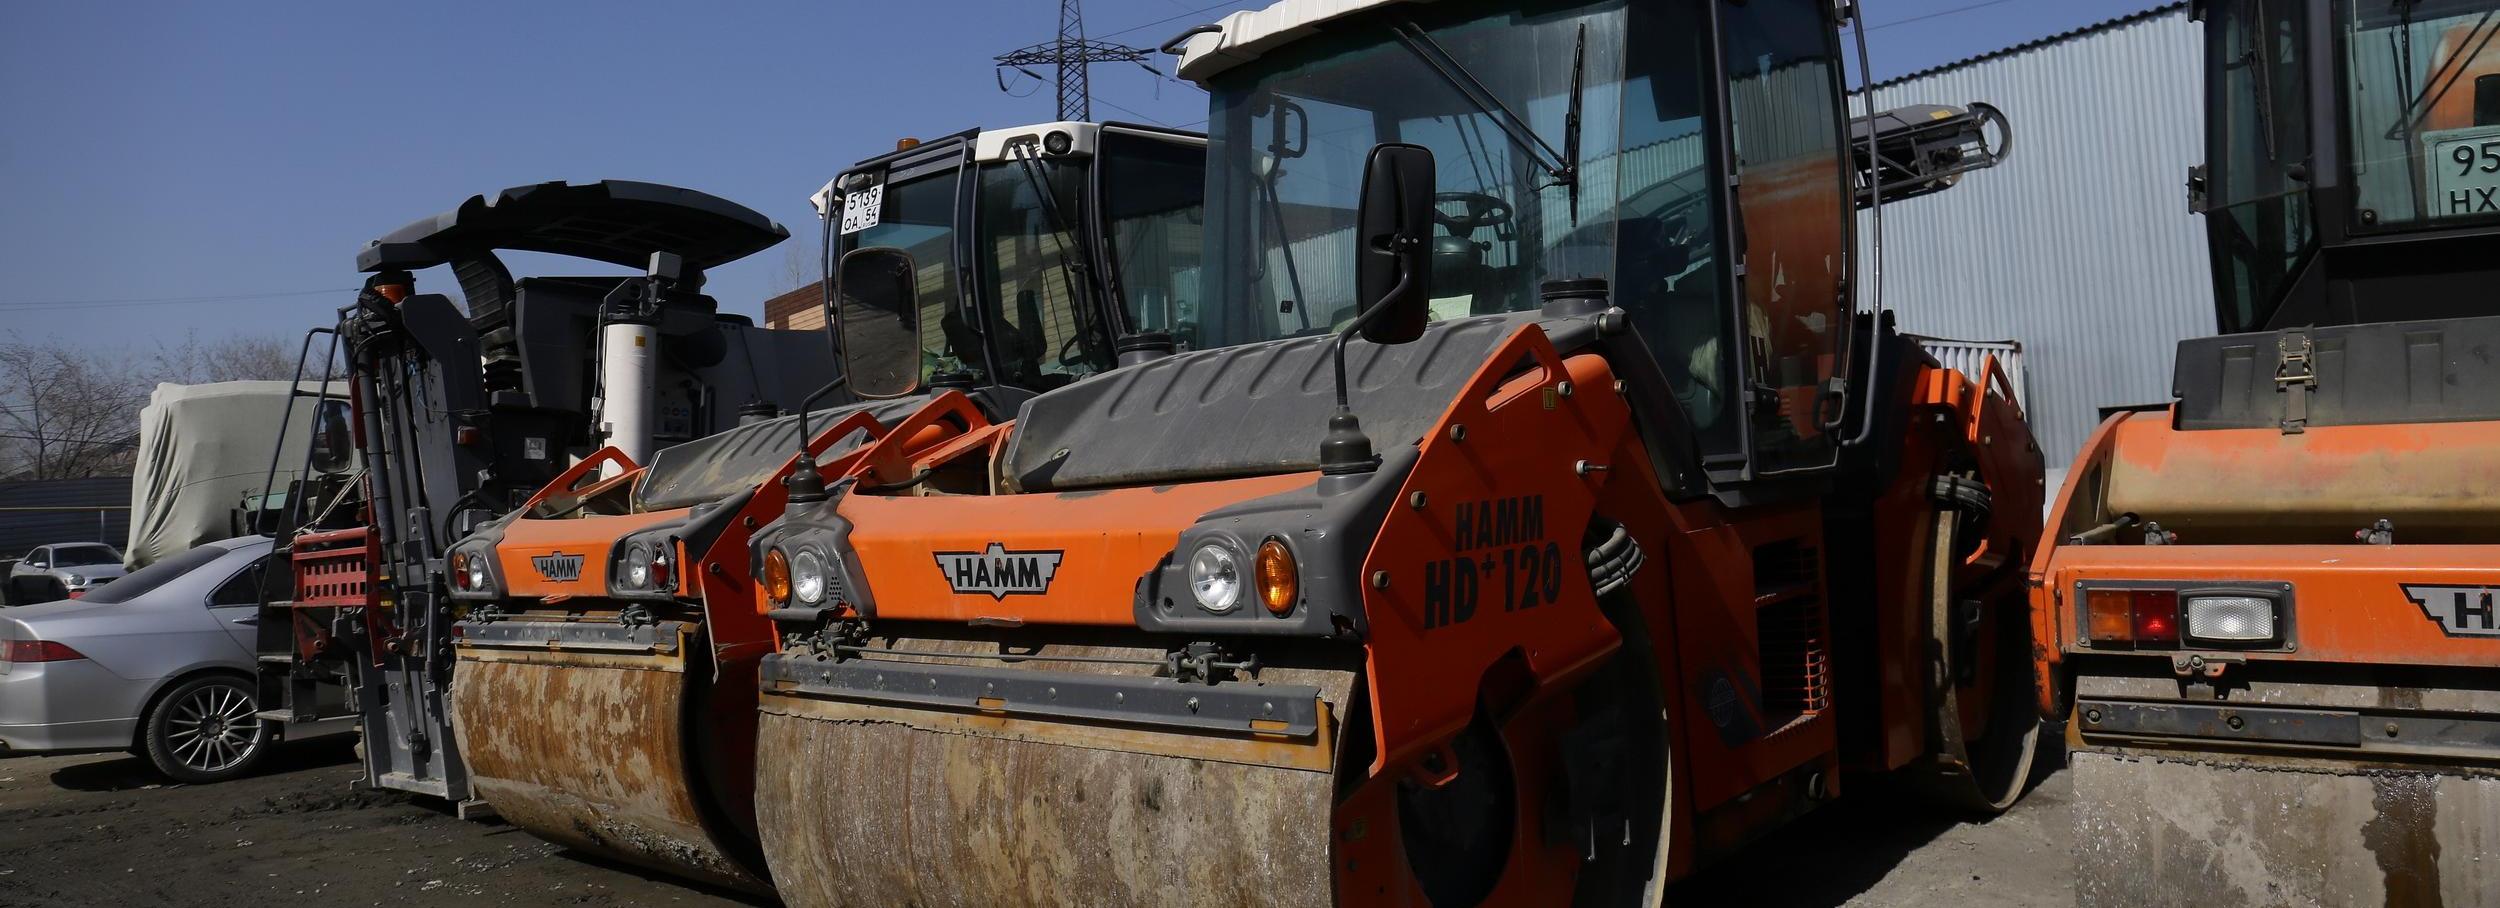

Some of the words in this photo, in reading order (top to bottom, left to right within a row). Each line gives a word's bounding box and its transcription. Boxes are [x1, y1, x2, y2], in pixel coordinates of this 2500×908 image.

[2453, 142, 2500, 176] 95
[850, 187, 878, 210] 5139
[865, 207, 877, 221] 54
[1455, 495, 1543, 551] HAMM
[541, 559, 577, 578] HAMM
[956, 558, 1041, 587] HAMM
[1504, 541, 1562, 612] 120
[2454, 592, 2500, 629] H
